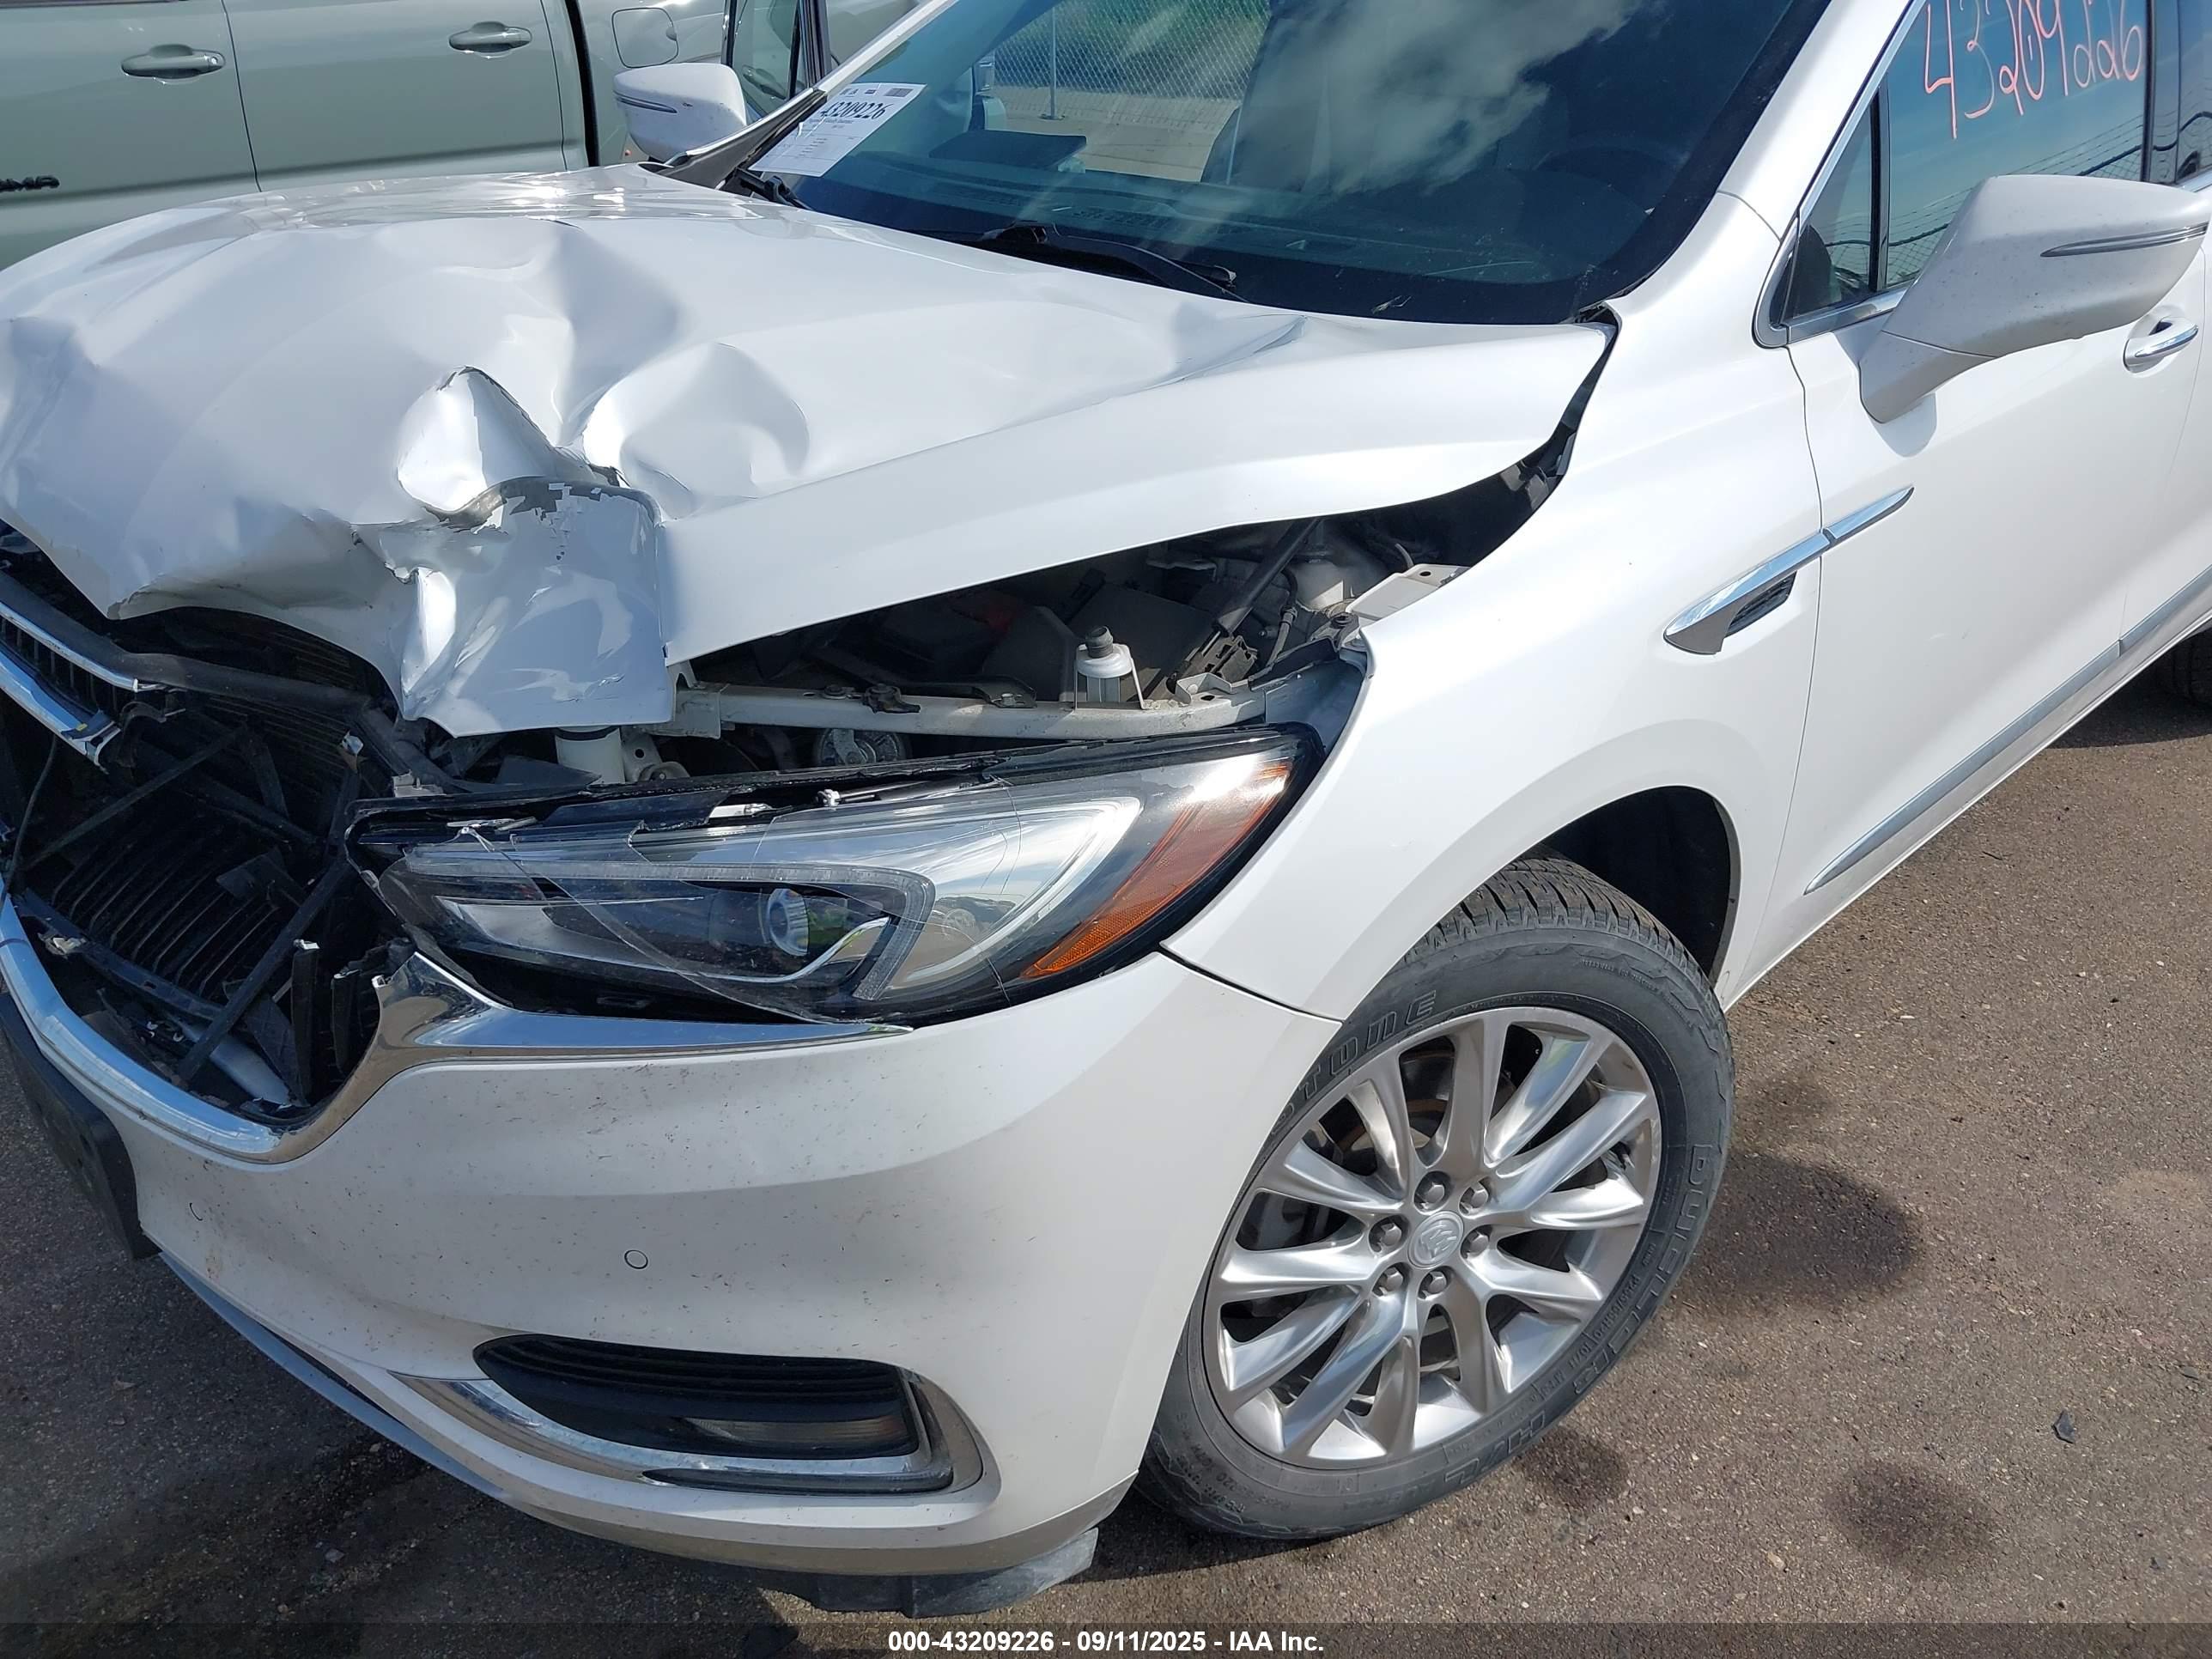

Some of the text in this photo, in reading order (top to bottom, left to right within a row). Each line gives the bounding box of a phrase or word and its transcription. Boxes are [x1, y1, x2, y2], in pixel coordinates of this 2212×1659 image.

[820, 101, 893, 119] 43209226
[1924, 0, 2143, 139] 43209226
[1573, 1143, 1713, 1395] DUELER
